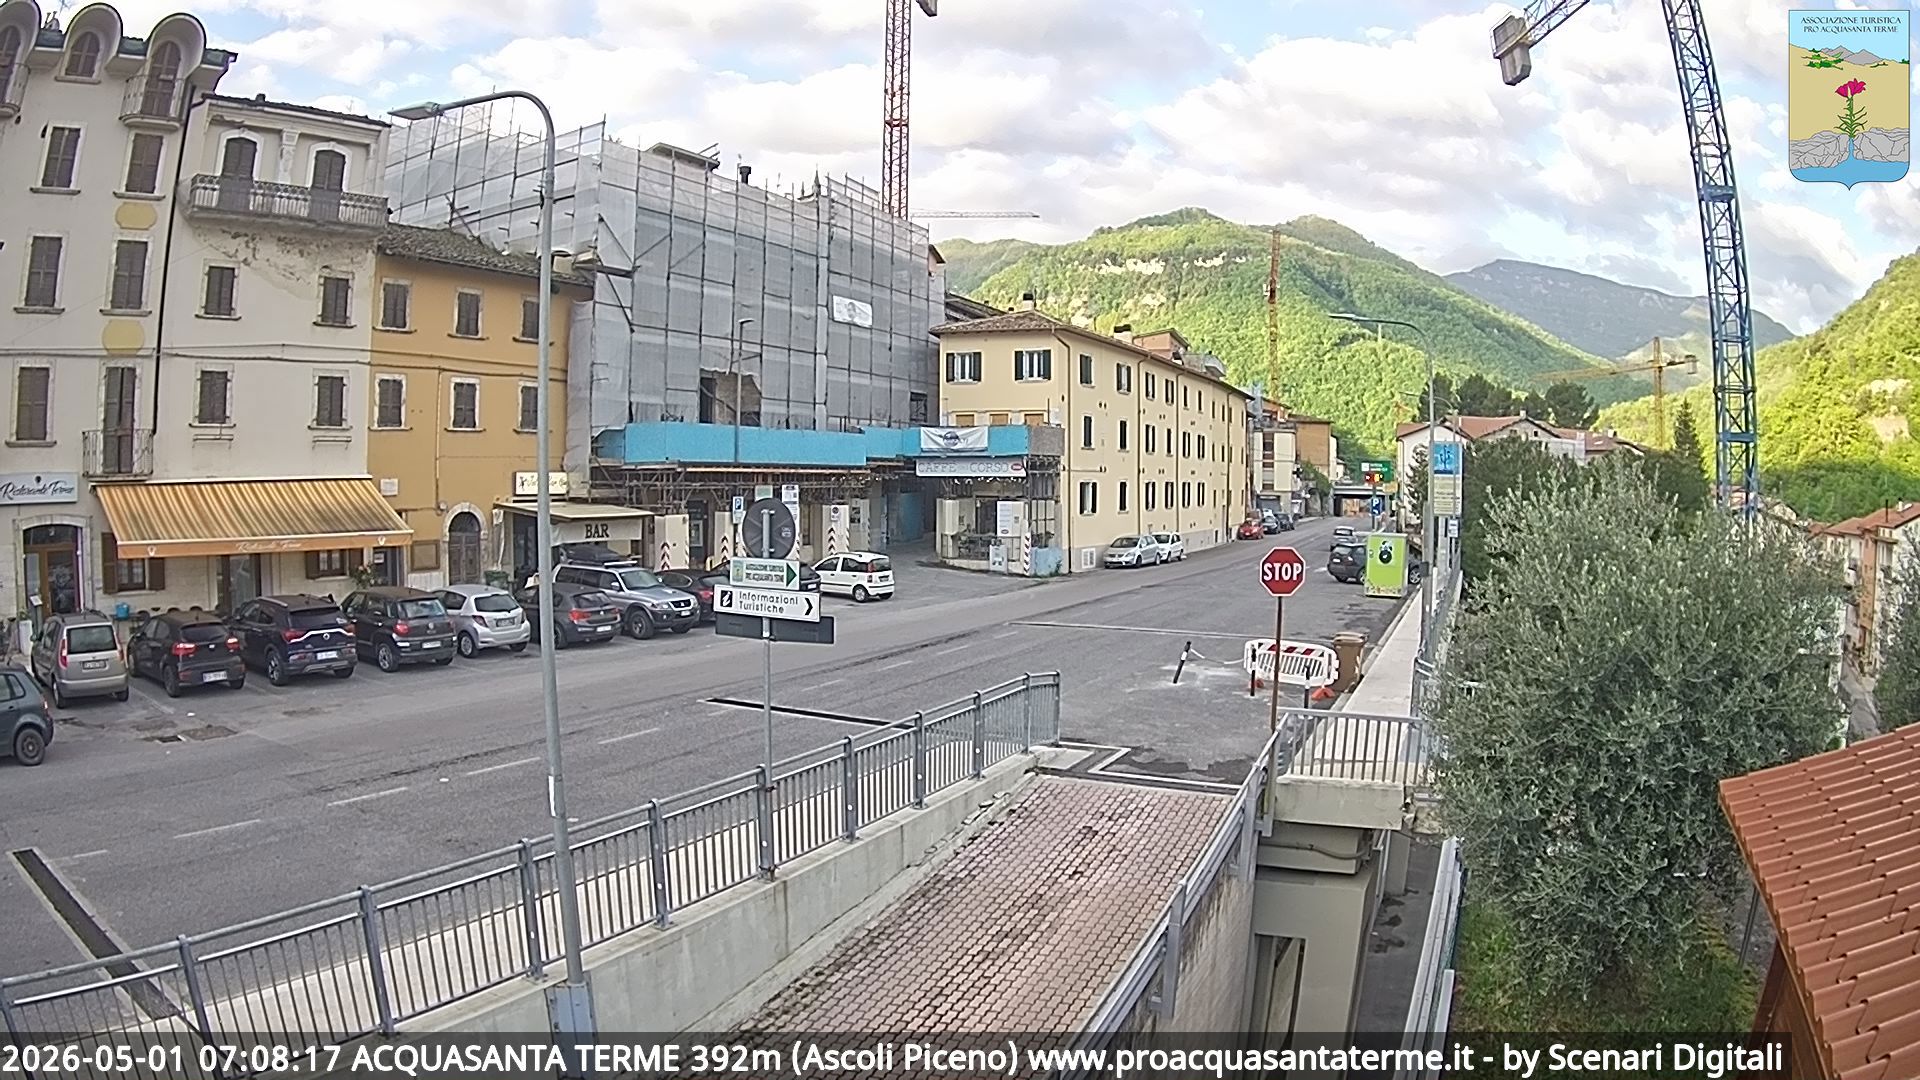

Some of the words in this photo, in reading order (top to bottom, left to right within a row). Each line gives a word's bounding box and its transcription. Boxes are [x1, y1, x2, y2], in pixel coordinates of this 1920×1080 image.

[969, 462, 1009, 473] CORSO
[585, 523, 609, 539] BAR
[1263, 562, 1302, 581] STOP
[739, 591, 798, 605] Informazioni
[739, 601, 784, 613] Turistiche
